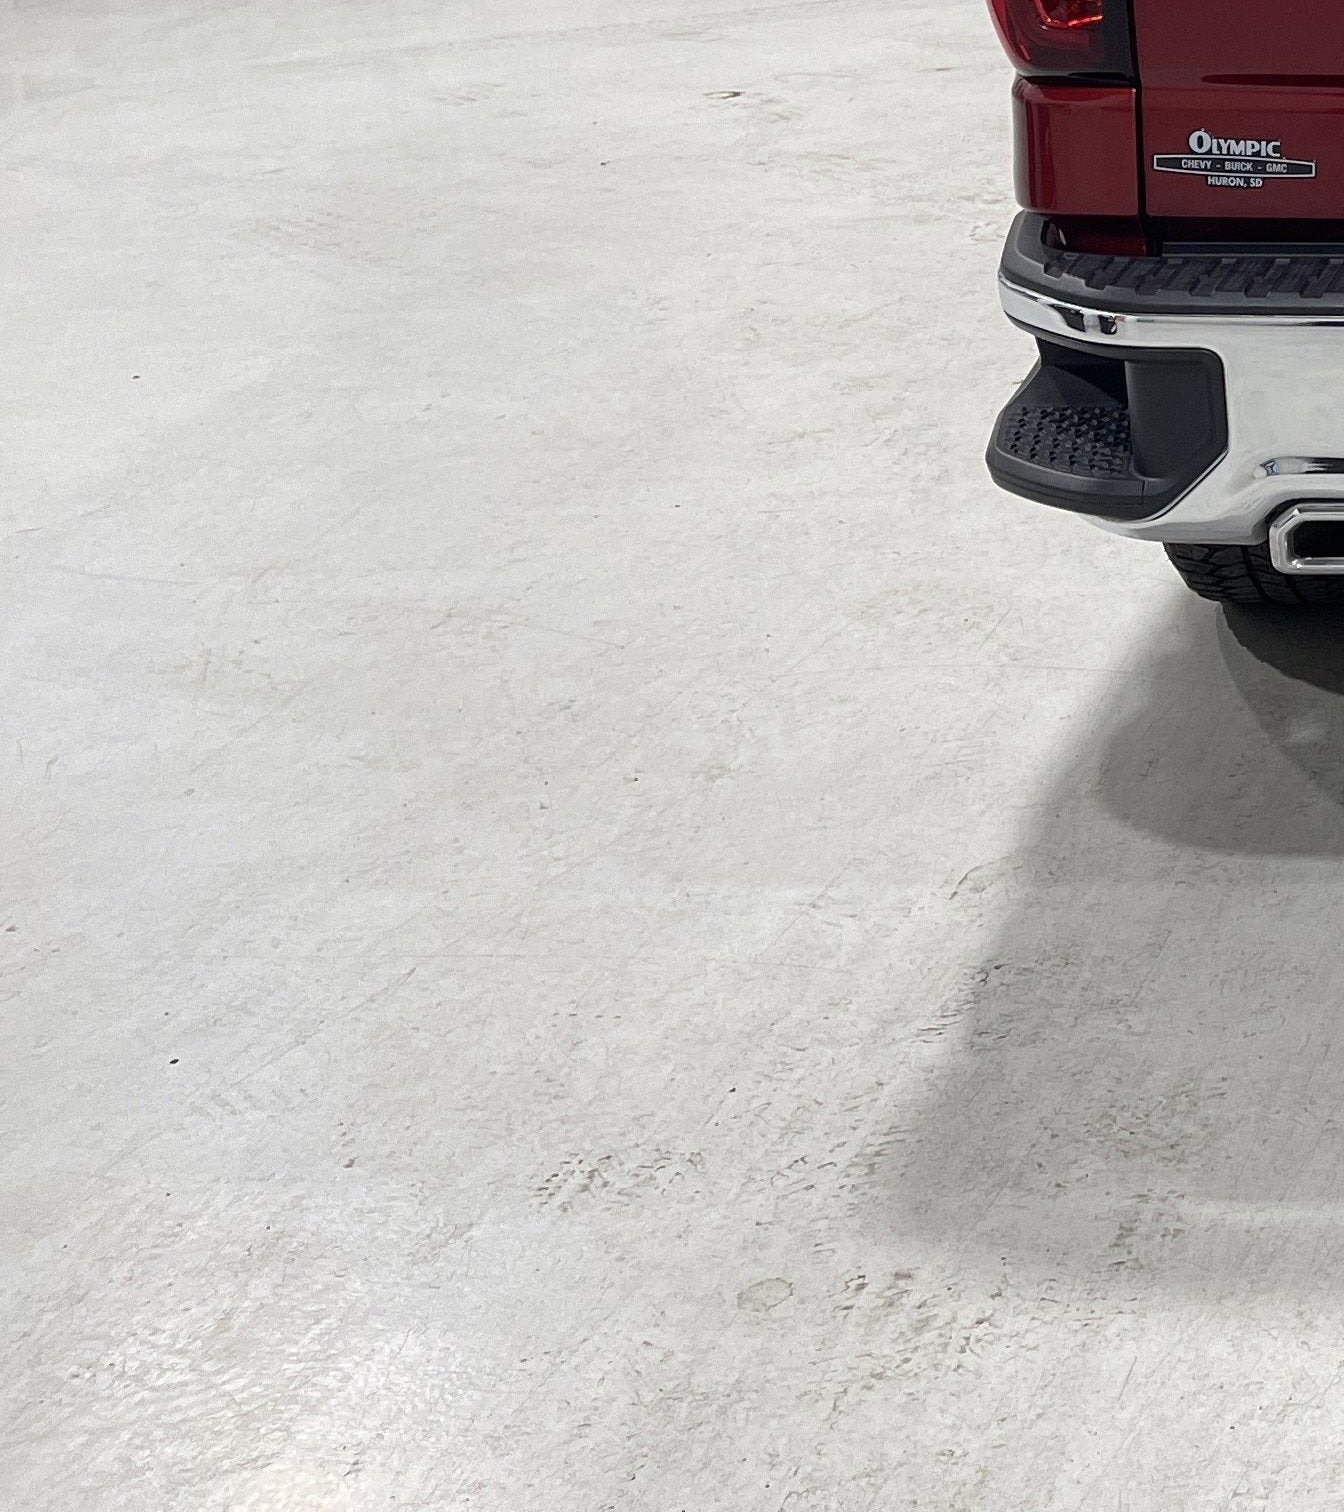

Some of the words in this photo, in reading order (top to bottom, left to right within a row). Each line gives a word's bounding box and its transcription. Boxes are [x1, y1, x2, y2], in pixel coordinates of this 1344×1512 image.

[1181, 158, 1212, 170] CHEVY
[1224, 162, 1253, 172] BUICK
[1265, 163, 1288, 173] GMC
[1207, 175, 1247, 188] HURON,
[1249, 177, 1263, 188] SD
